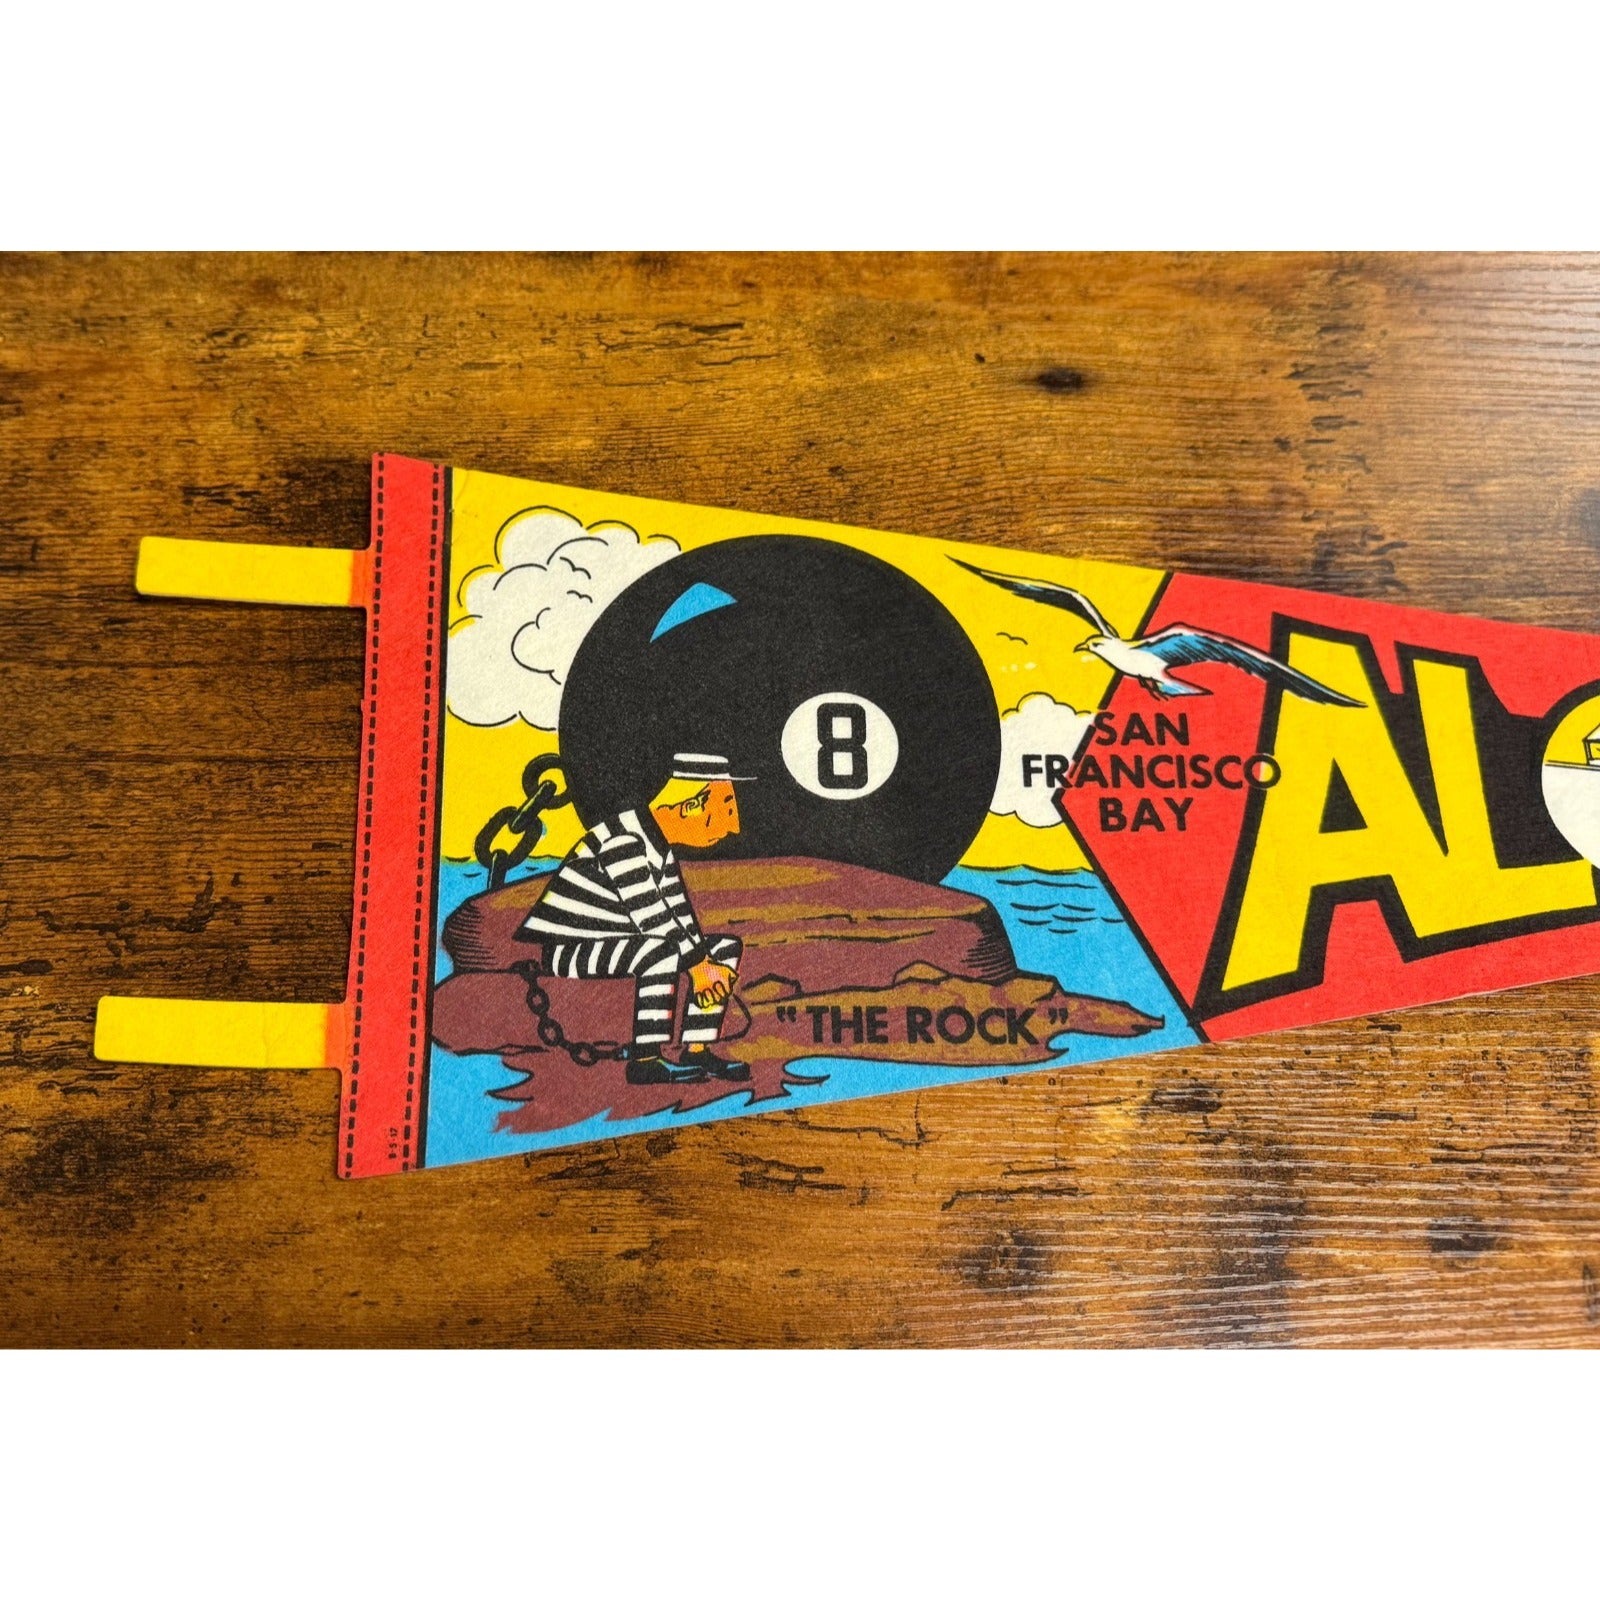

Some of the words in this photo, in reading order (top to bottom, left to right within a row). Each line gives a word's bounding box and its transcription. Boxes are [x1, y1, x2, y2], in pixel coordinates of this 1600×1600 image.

[817, 702, 868, 790] 8
[1094, 712, 1190, 746] SAN
[1022, 754, 1282, 790] FRANCISCO
[1099, 797, 1193, 832] BAY
